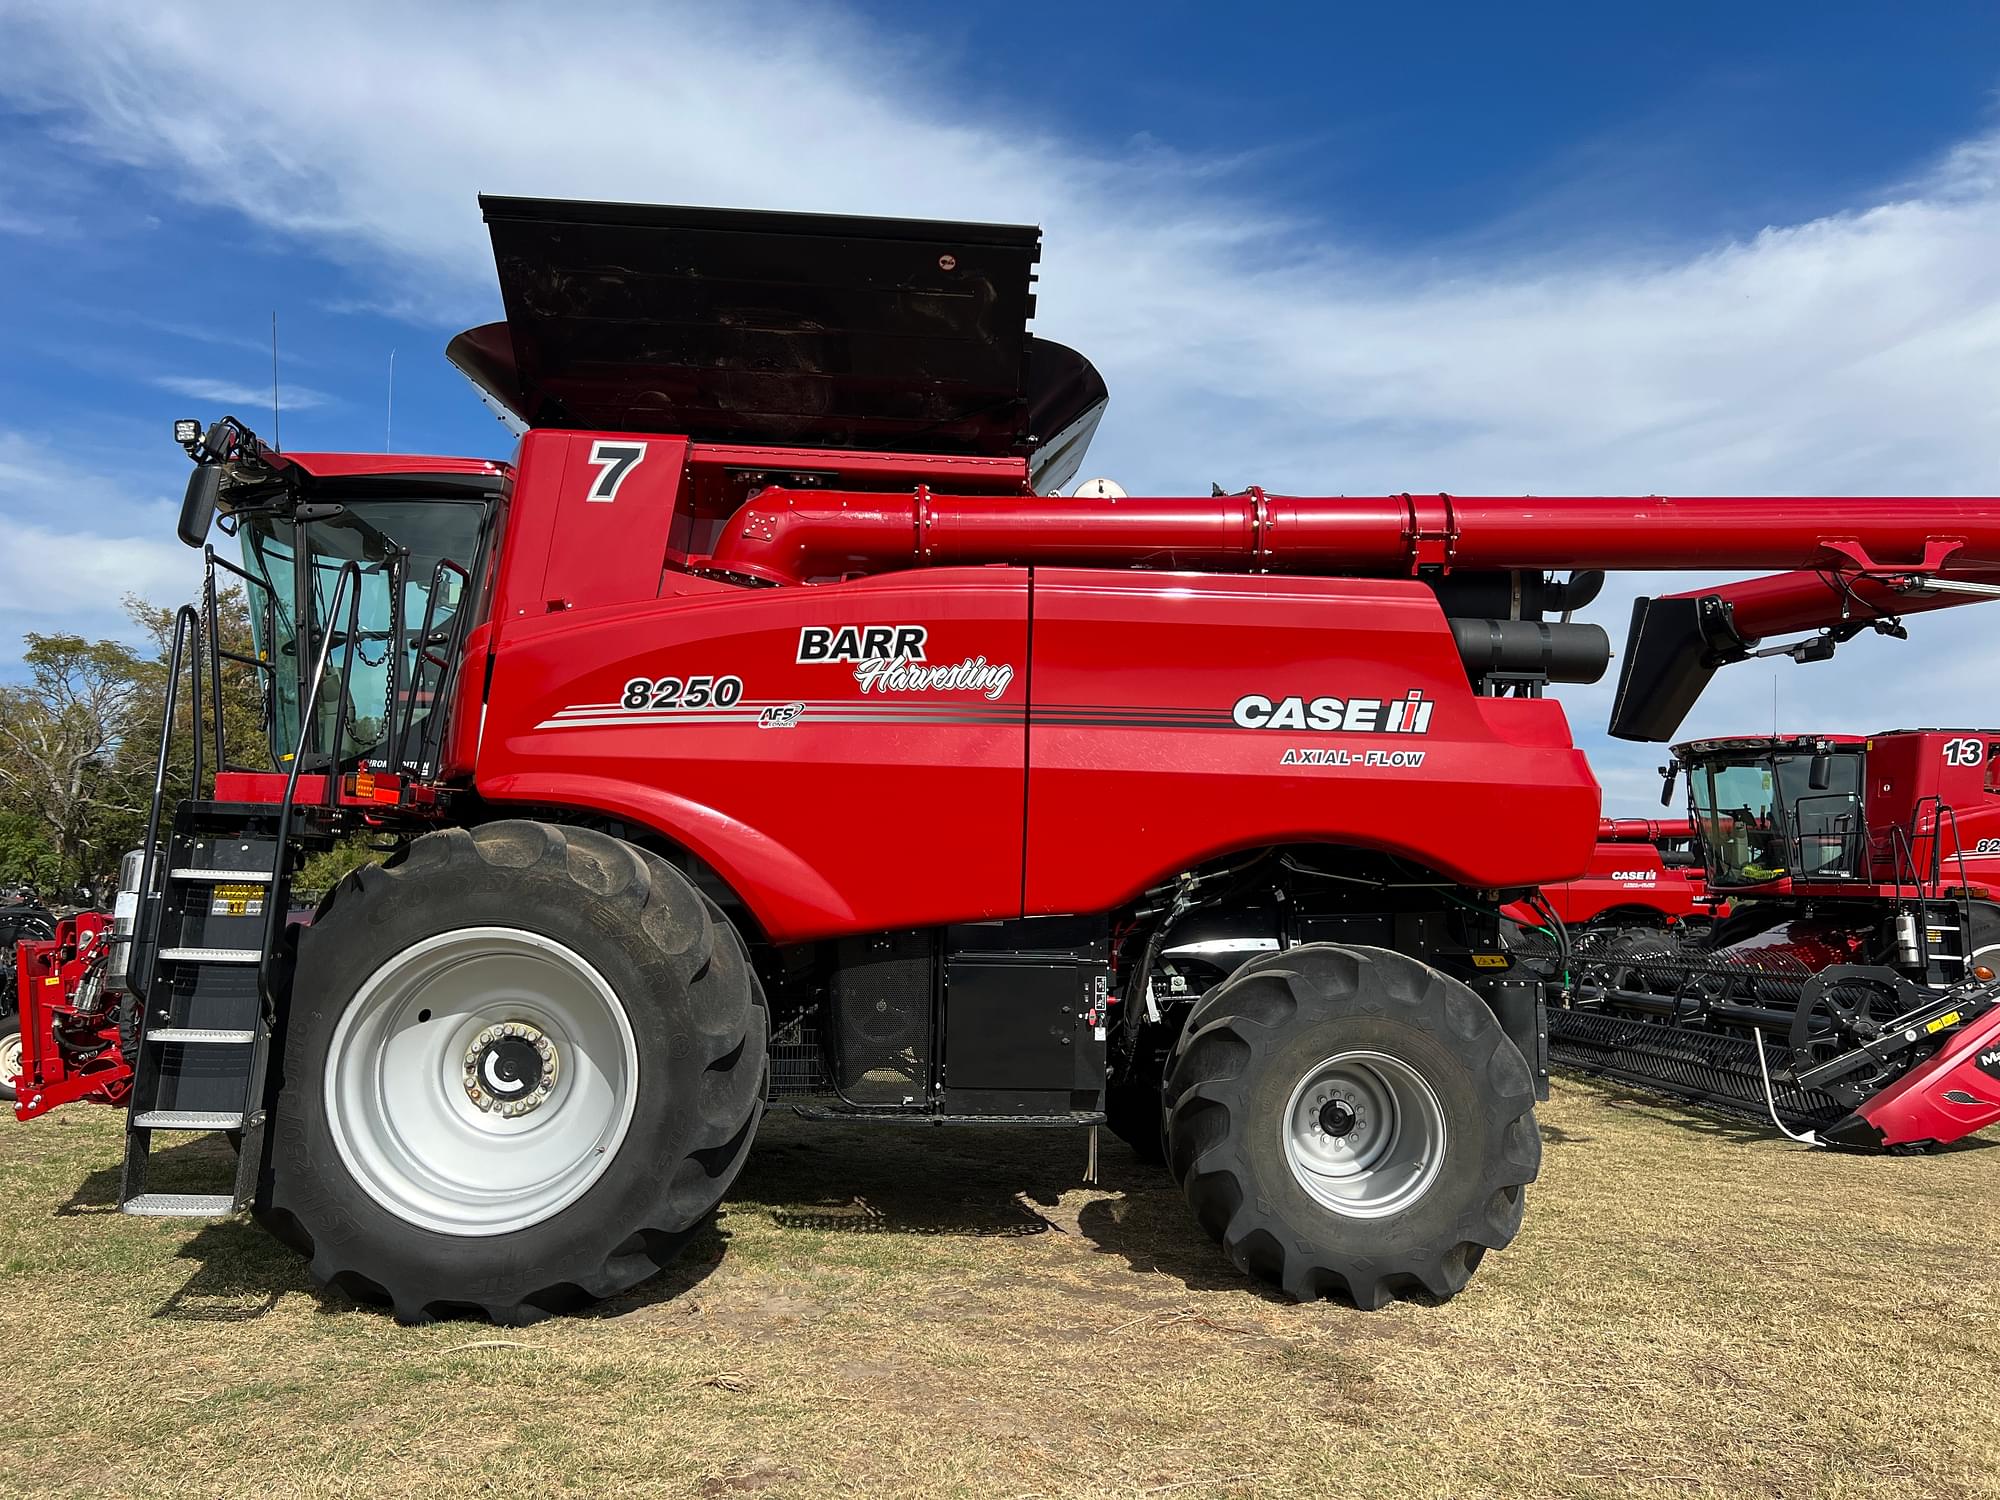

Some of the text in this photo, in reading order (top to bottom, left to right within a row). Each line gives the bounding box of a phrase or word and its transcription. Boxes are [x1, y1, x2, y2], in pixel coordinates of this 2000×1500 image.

[586, 440, 648, 503] 7
[796, 626, 928, 664] BARR
[621, 675, 743, 710] 8250
[854, 654, 1014, 700] Harvesting
[759, 706, 796, 721] AFS
[1233, 694, 1381, 731] CASE
[1280, 748, 1425, 768] AXIAL-FLOW
[1943, 738, 1983, 766] 13
[1611, 871, 1646, 881] CASE
